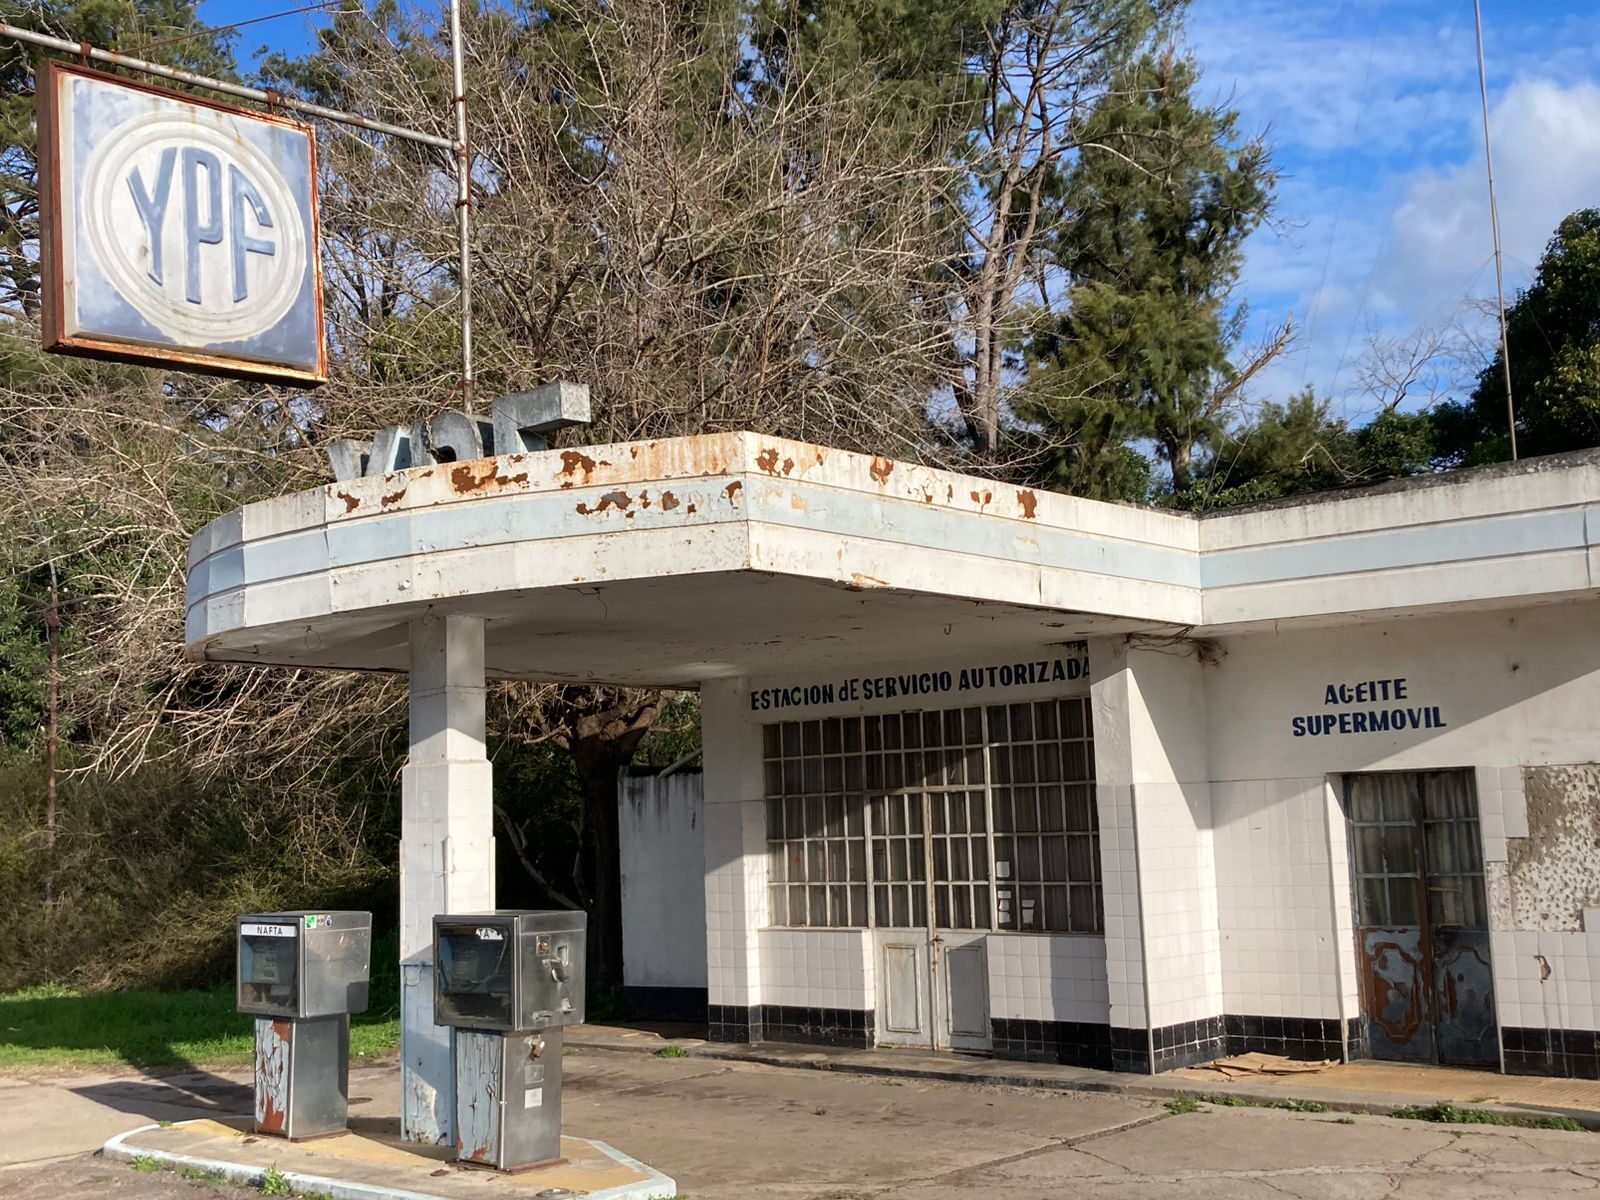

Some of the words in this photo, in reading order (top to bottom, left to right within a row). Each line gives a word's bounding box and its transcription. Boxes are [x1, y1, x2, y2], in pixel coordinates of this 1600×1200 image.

[126, 146, 275, 305] YPF
[751, 684, 834, 710] ESTACION
[862, 671, 952, 700] SERVICIO
[1324, 678, 1408, 705] ACEITE
[1292, 706, 1447, 737] SUPERMOVIL
[256, 926, 283, 936] NAFTA
